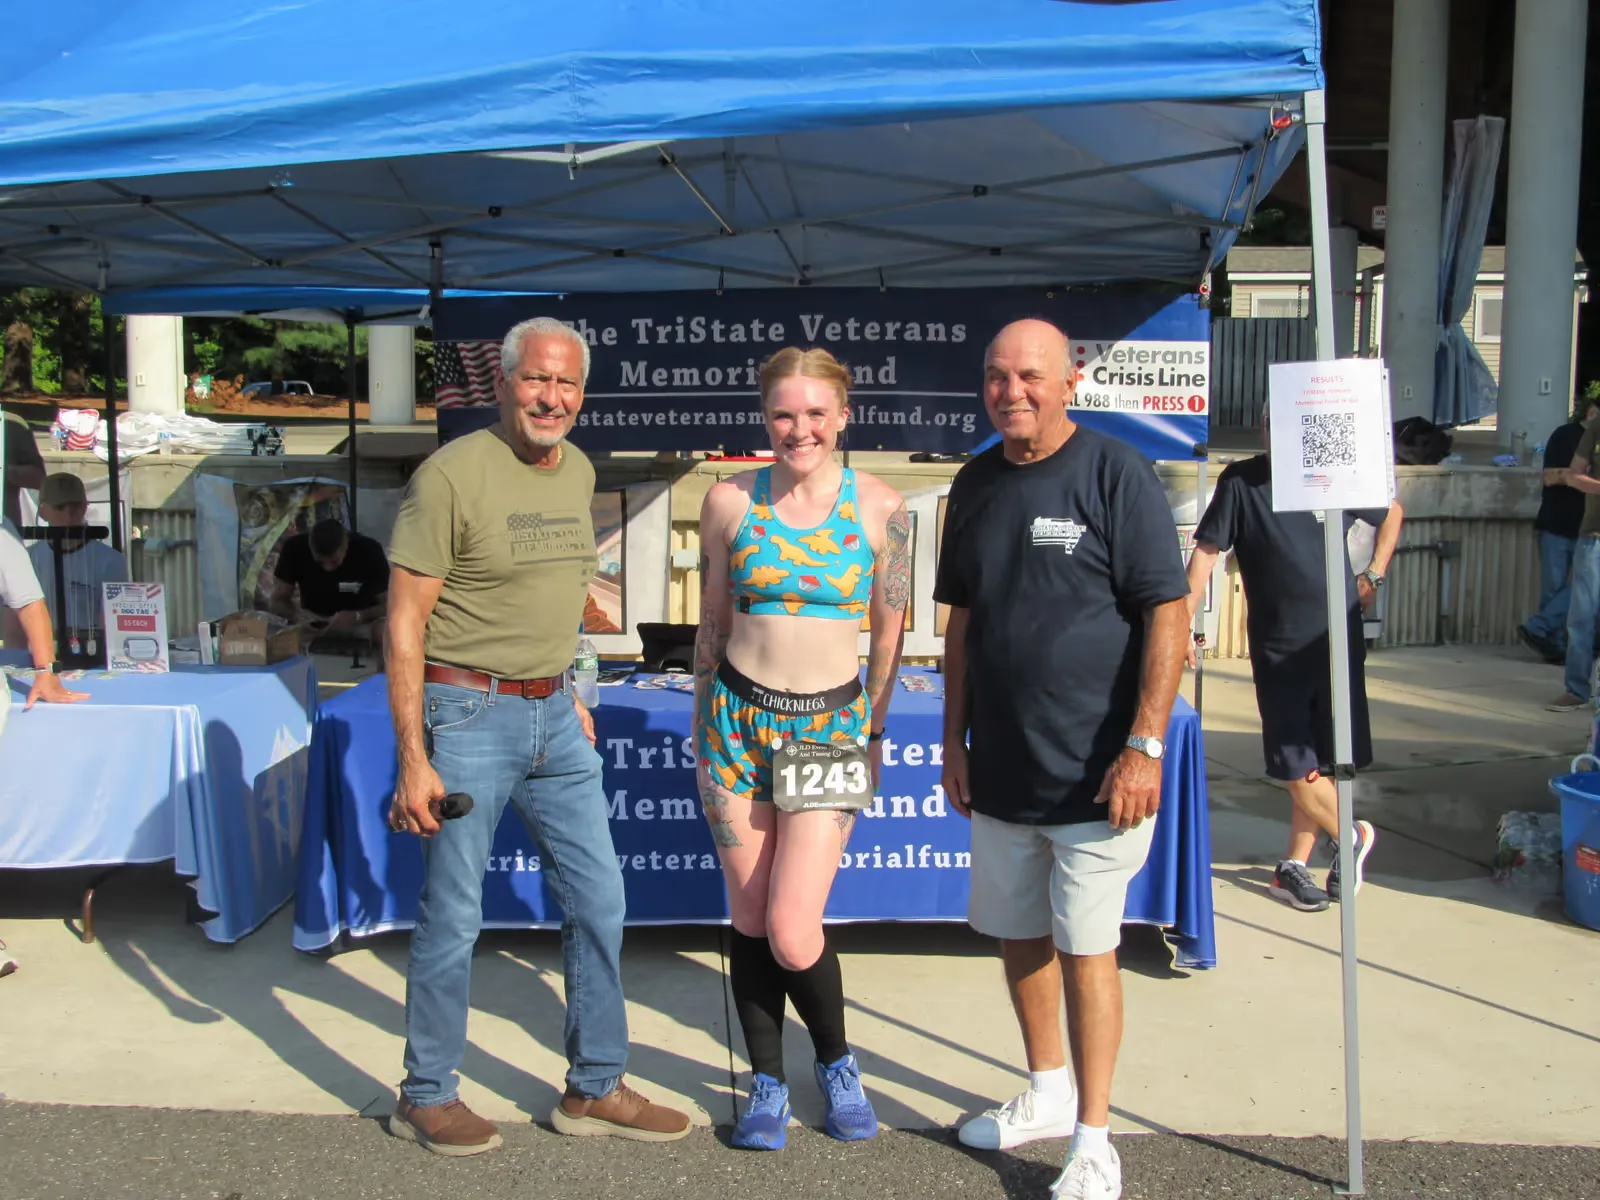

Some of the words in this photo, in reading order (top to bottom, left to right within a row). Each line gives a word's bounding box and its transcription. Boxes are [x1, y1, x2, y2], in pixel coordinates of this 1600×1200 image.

[631, 315, 785, 345] TriState
[799, 314, 967, 343] Veterans
[1095, 343, 1205, 364] Veterans
[619, 358, 757, 387] Memori
[853, 356, 897, 385] nd
[1092, 366, 1155, 386] Crisis
[1158, 367, 1206, 388] Line
[1310, 376, 1344, 384] RESULTS
[1084, 392, 1110, 408] 988
[1114, 393, 1139, 409] then
[1142, 395, 1185, 411] PRESS
[763, 693, 826, 712] CHICKNLEGS
[606, 737, 697, 769] TriS
[780, 761, 868, 797] 1243
[863, 784, 947, 818] und
